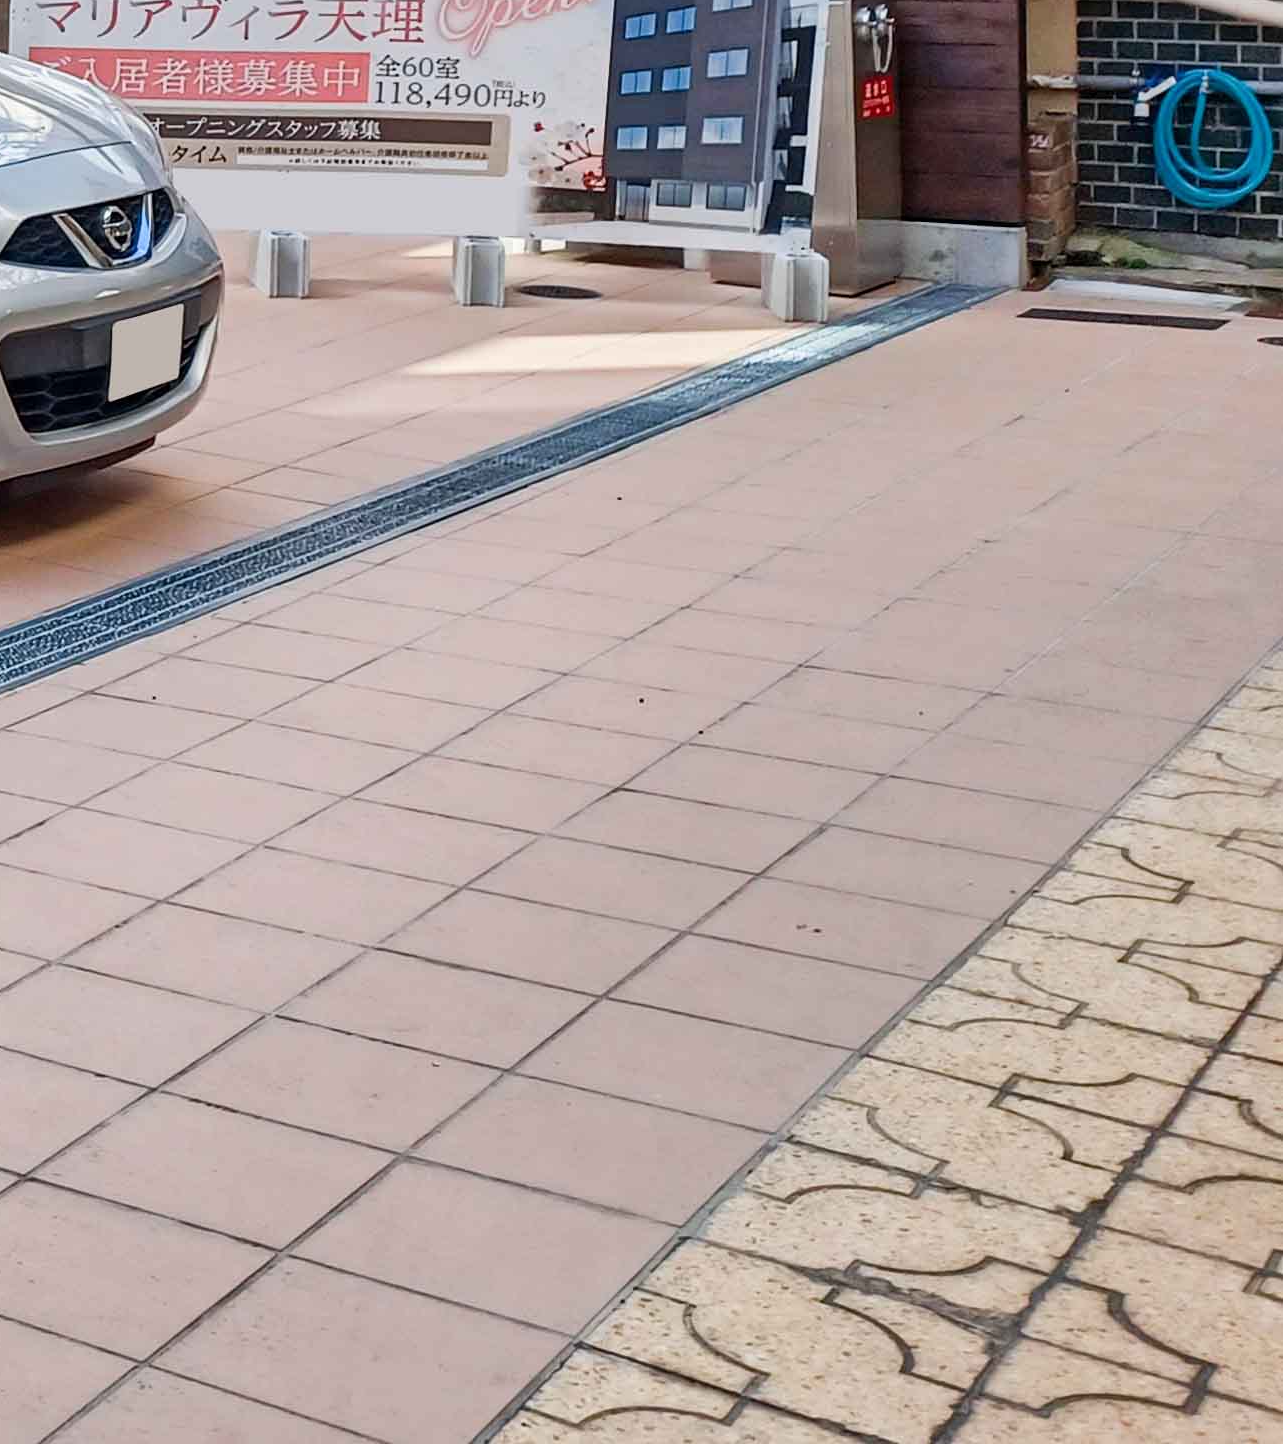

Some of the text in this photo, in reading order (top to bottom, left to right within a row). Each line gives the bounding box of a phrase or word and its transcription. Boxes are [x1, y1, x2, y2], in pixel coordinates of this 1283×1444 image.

[376, 55, 460, 80] 全60室
[375, 82, 546, 109] 118,490円より
